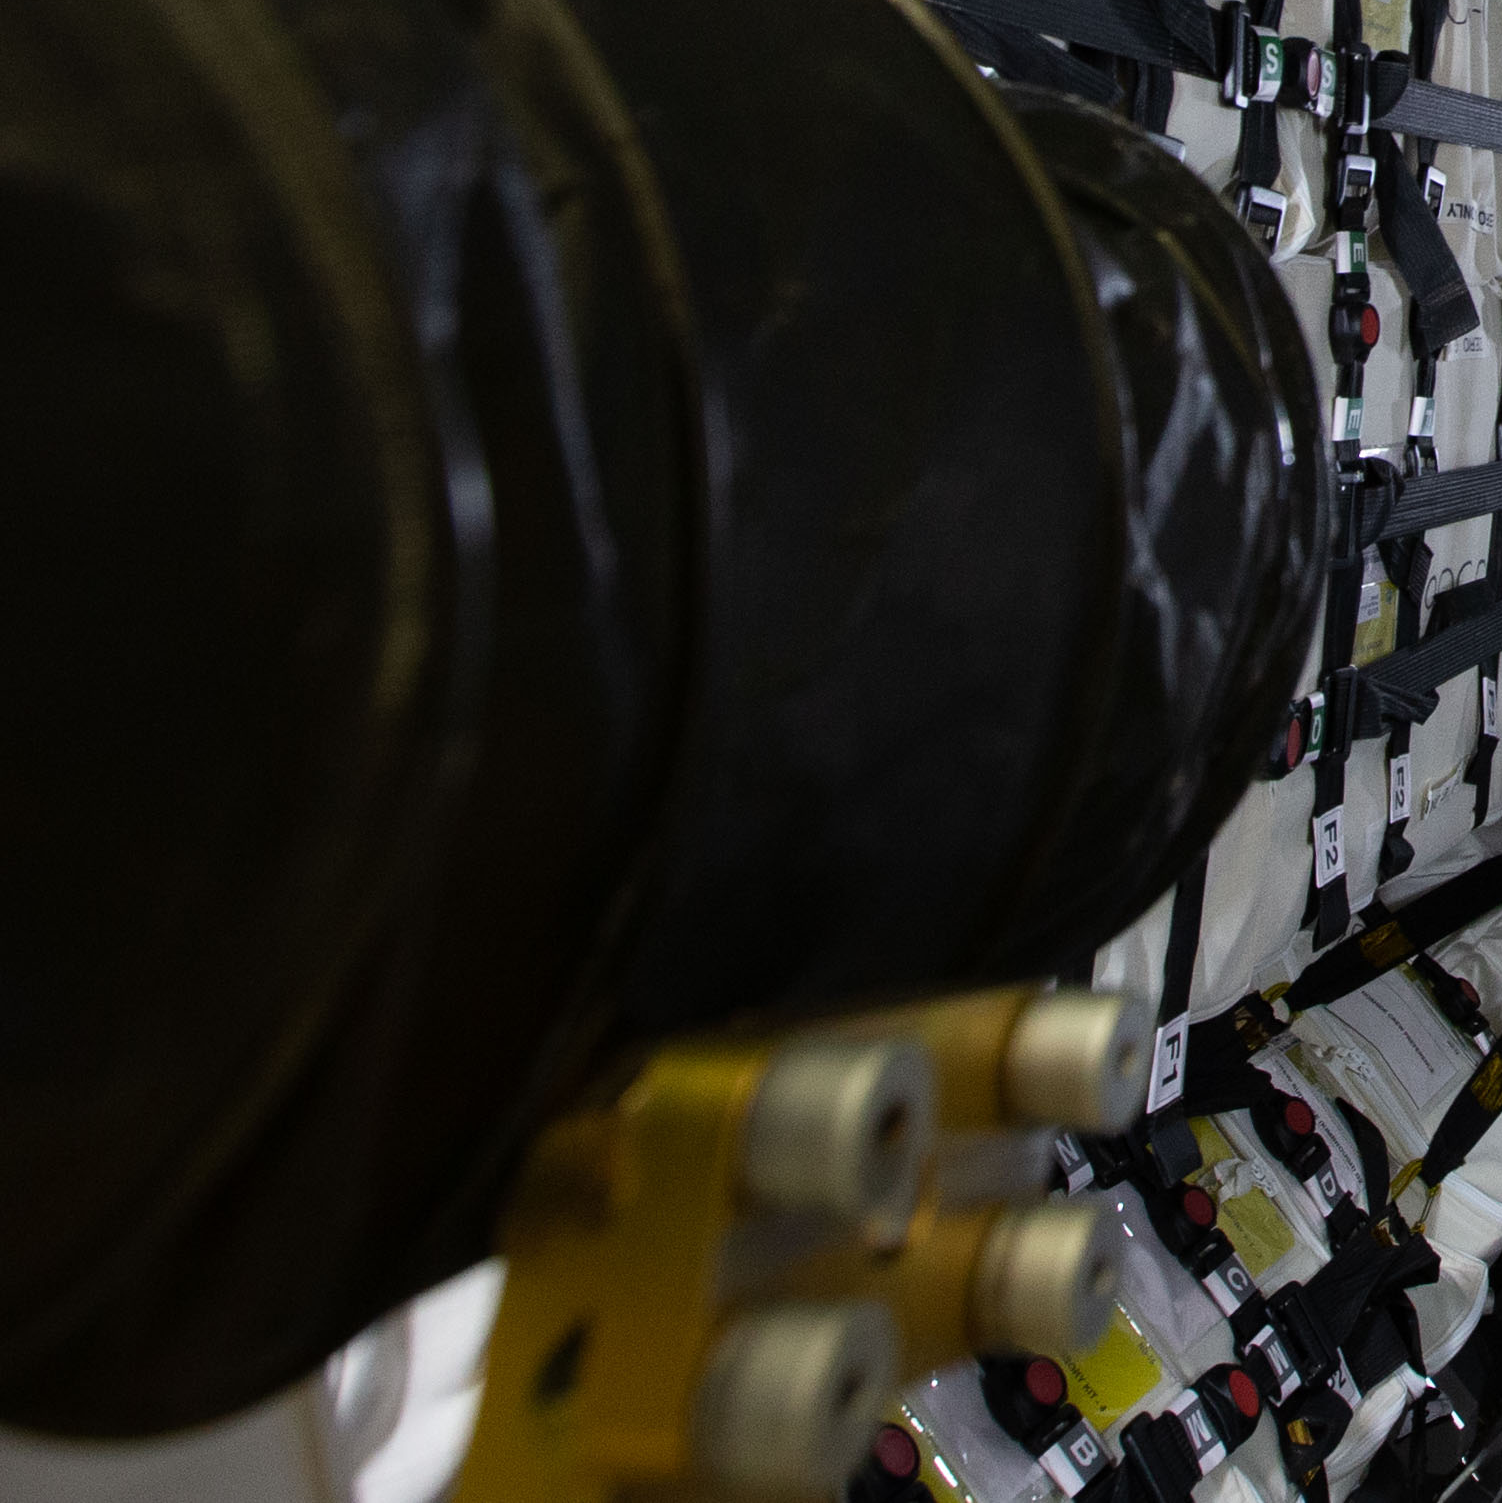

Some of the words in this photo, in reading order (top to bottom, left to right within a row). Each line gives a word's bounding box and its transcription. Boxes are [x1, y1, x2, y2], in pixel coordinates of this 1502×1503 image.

[1266, 45, 1279, 75] S
[1322, 61, 1334, 90] S
[1353, 242, 1365, 264] E
[1350, 408, 1362, 429] E
[1487, 688, 1497, 721] F2
[1396, 765, 1406, 811] F2
[1323, 819, 1339, 871] F2
[1161, 1031, 1182, 1087] F1
[1320, 1171, 1337, 1198] D
[1228, 1266, 1248, 1291] C
[1069, 1431, 1099, 1467] B
